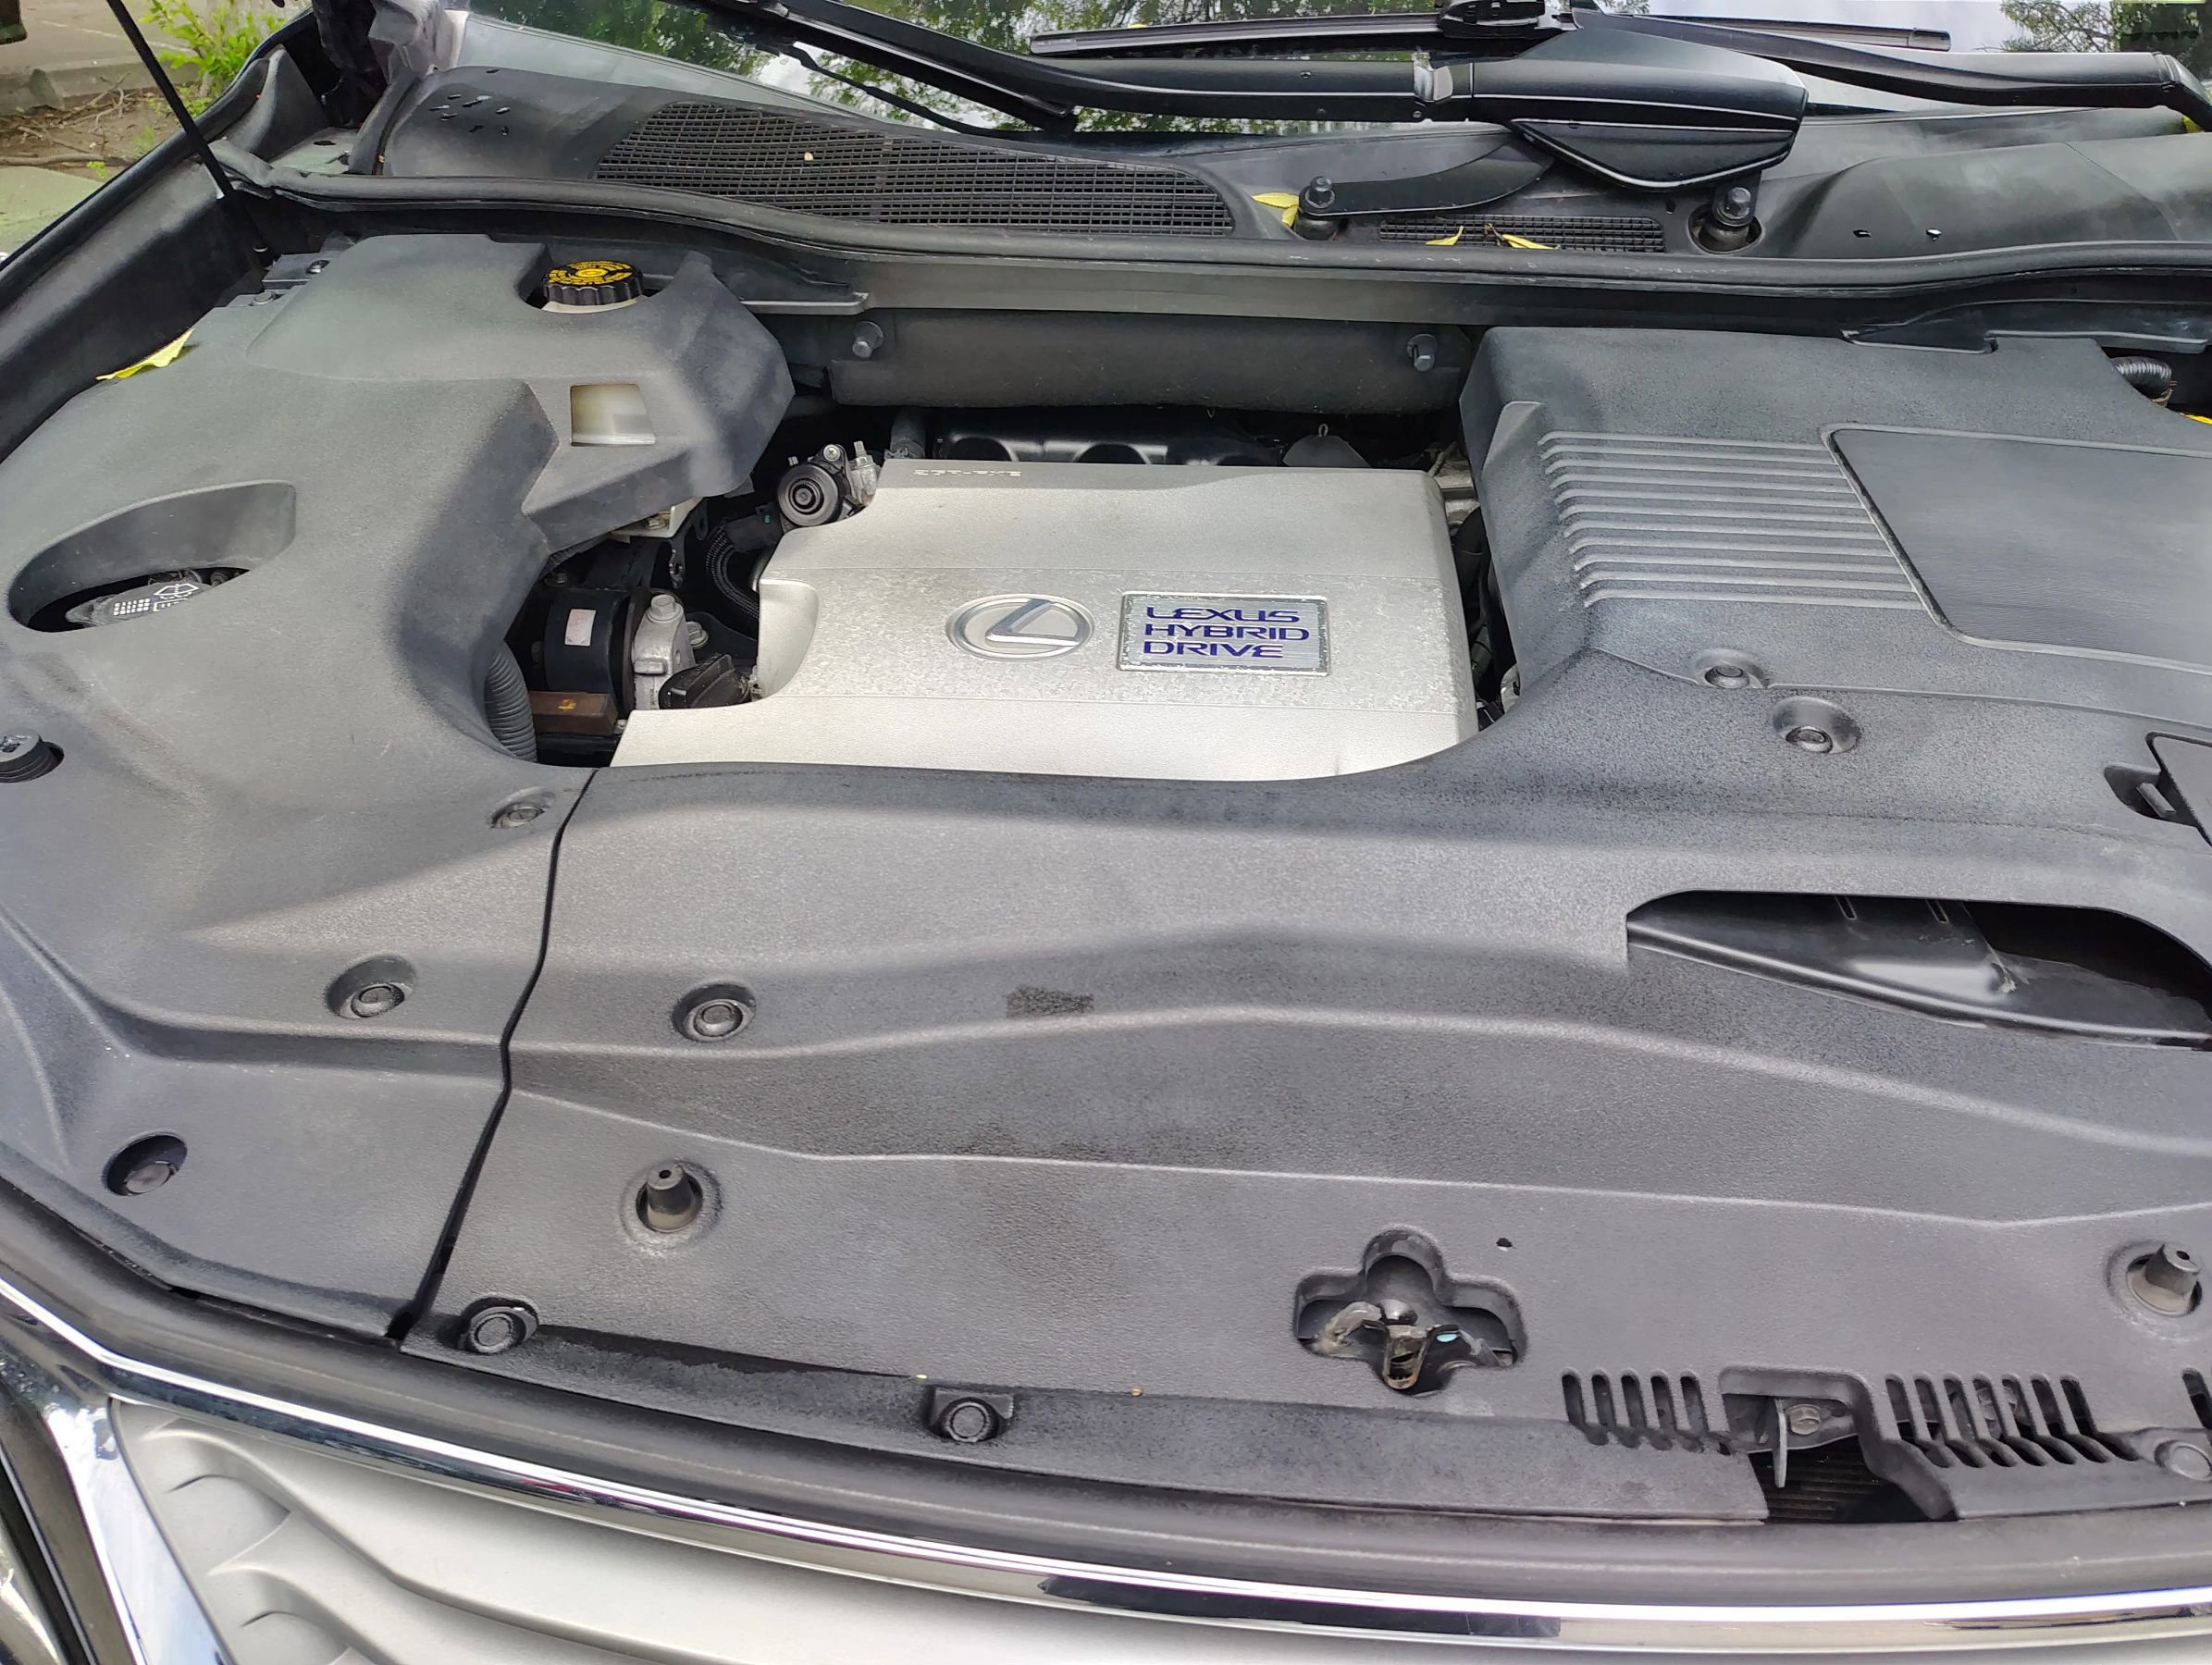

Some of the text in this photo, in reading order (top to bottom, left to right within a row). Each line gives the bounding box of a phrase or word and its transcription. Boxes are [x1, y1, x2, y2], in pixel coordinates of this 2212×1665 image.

[1146, 606, 1300, 623] LEXUS
[1144, 623, 1310, 641] HYBRID
[1143, 640, 1284, 659] DRIVE
